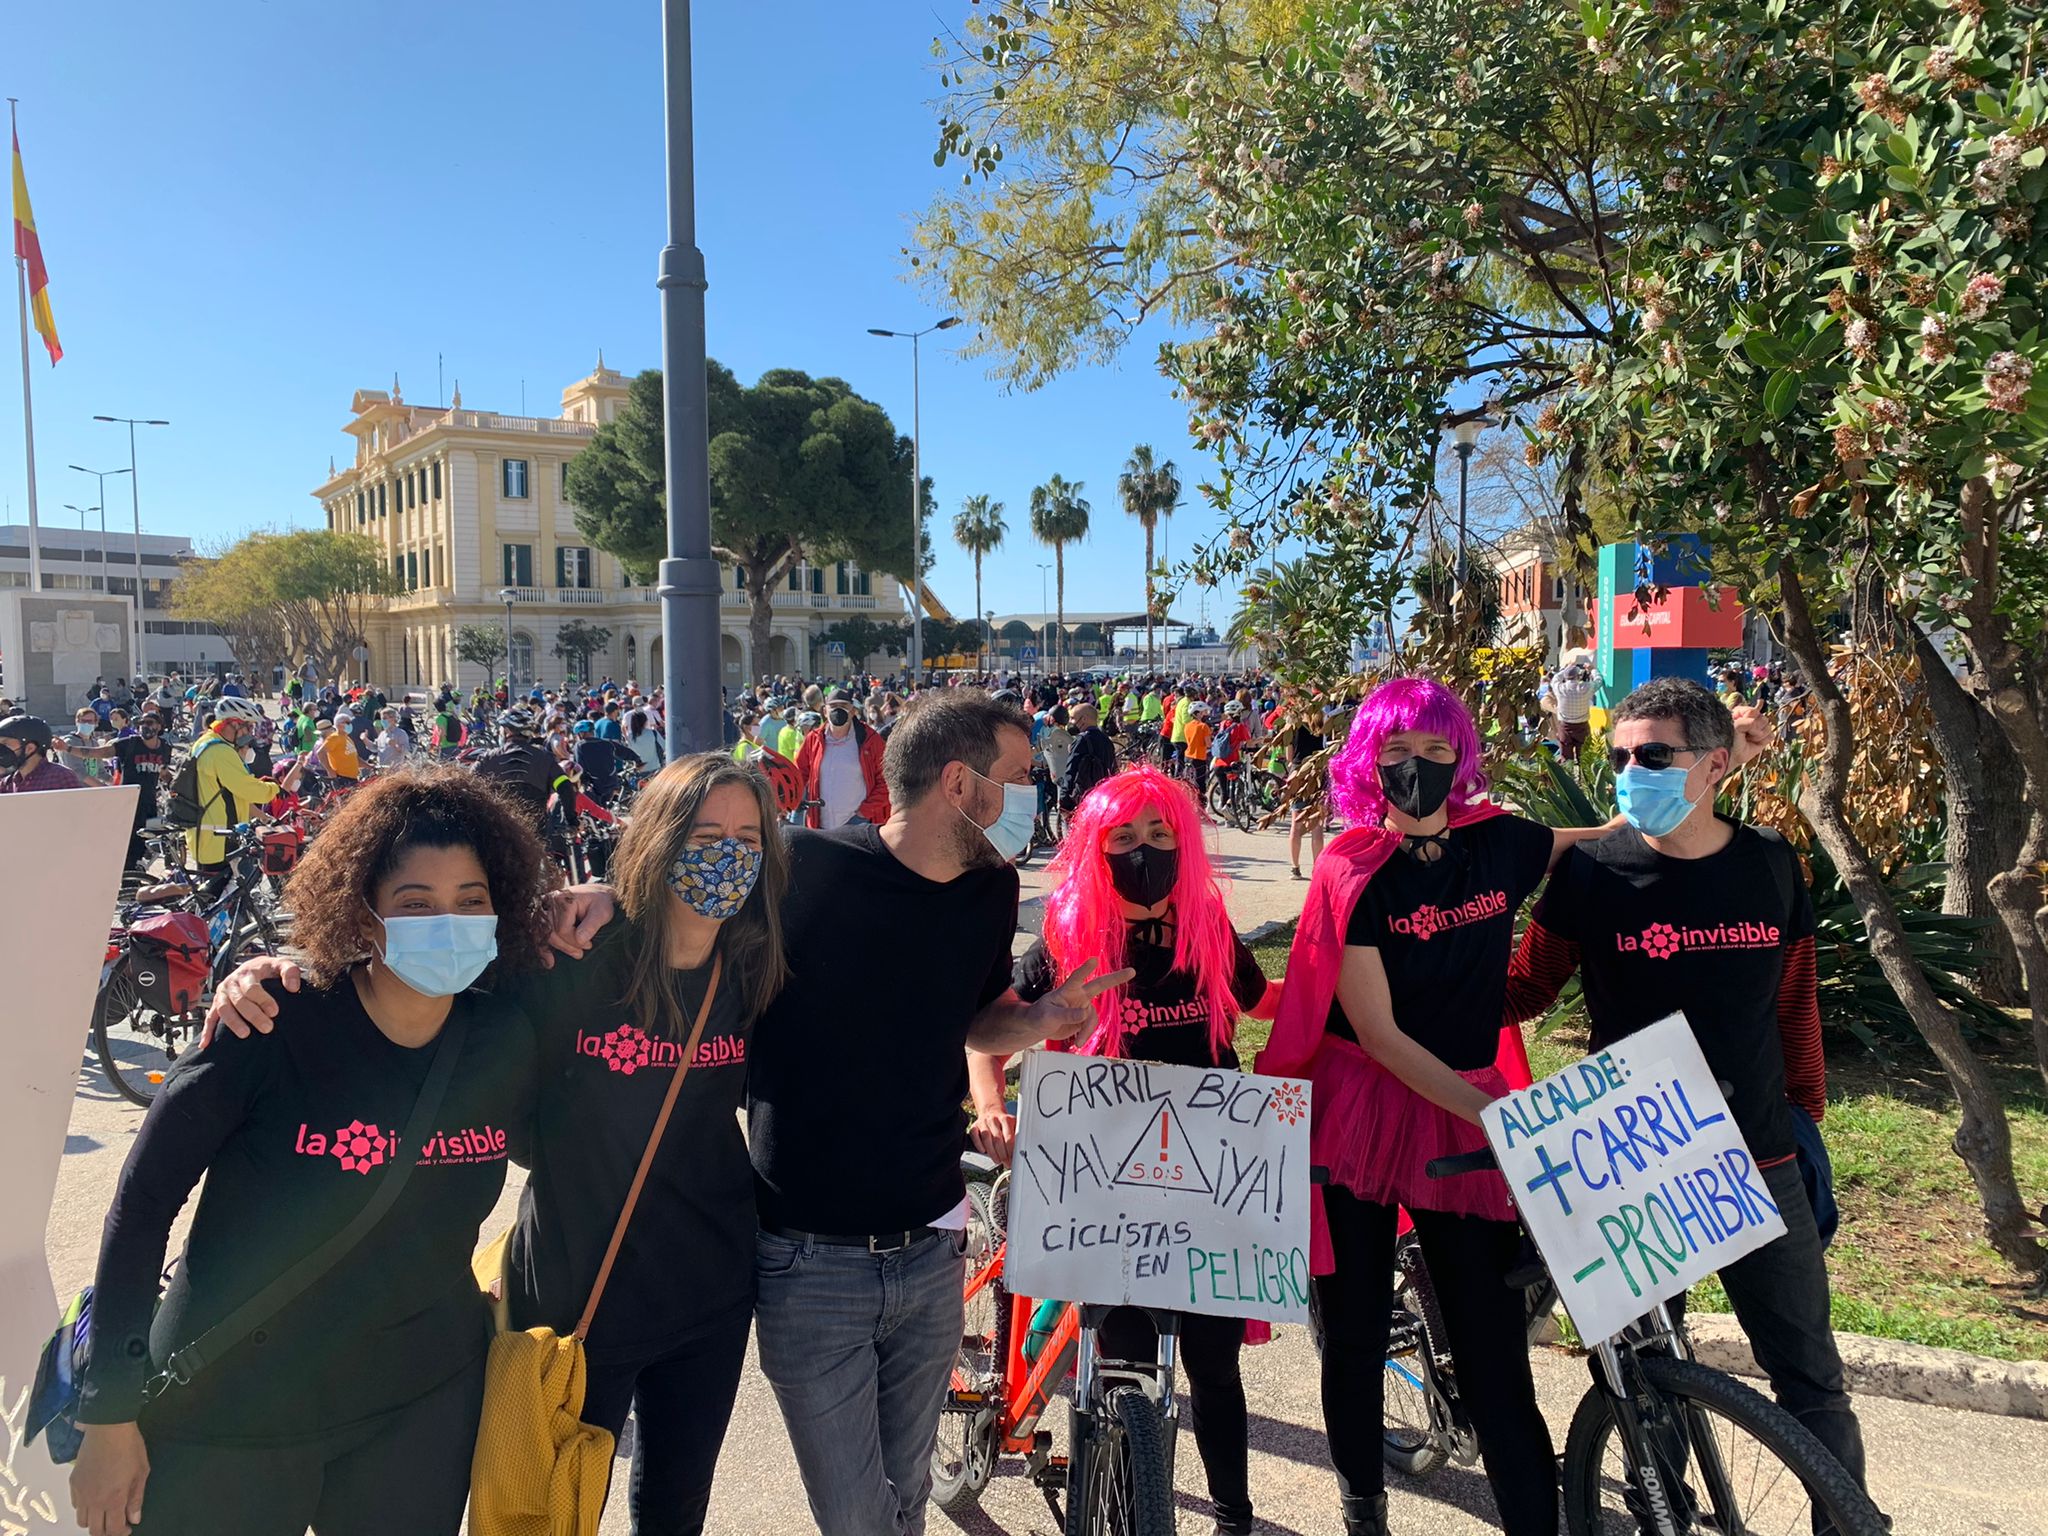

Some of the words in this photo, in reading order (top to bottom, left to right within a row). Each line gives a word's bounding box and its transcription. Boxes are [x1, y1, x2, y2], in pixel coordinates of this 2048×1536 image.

[1388, 914, 1411, 934] la
[1436, 889, 1507, 928] invisible
[1616, 932, 1638, 951] la
[1682, 921, 1780, 946] invisible
[576, 1028, 601, 1057] la
[1499, 1051, 1631, 1149] ALCALDE:
[295, 1123, 327, 1155] la
[389, 1125, 506, 1158] ivisible
[1136, 1252, 1170, 1279] EN
